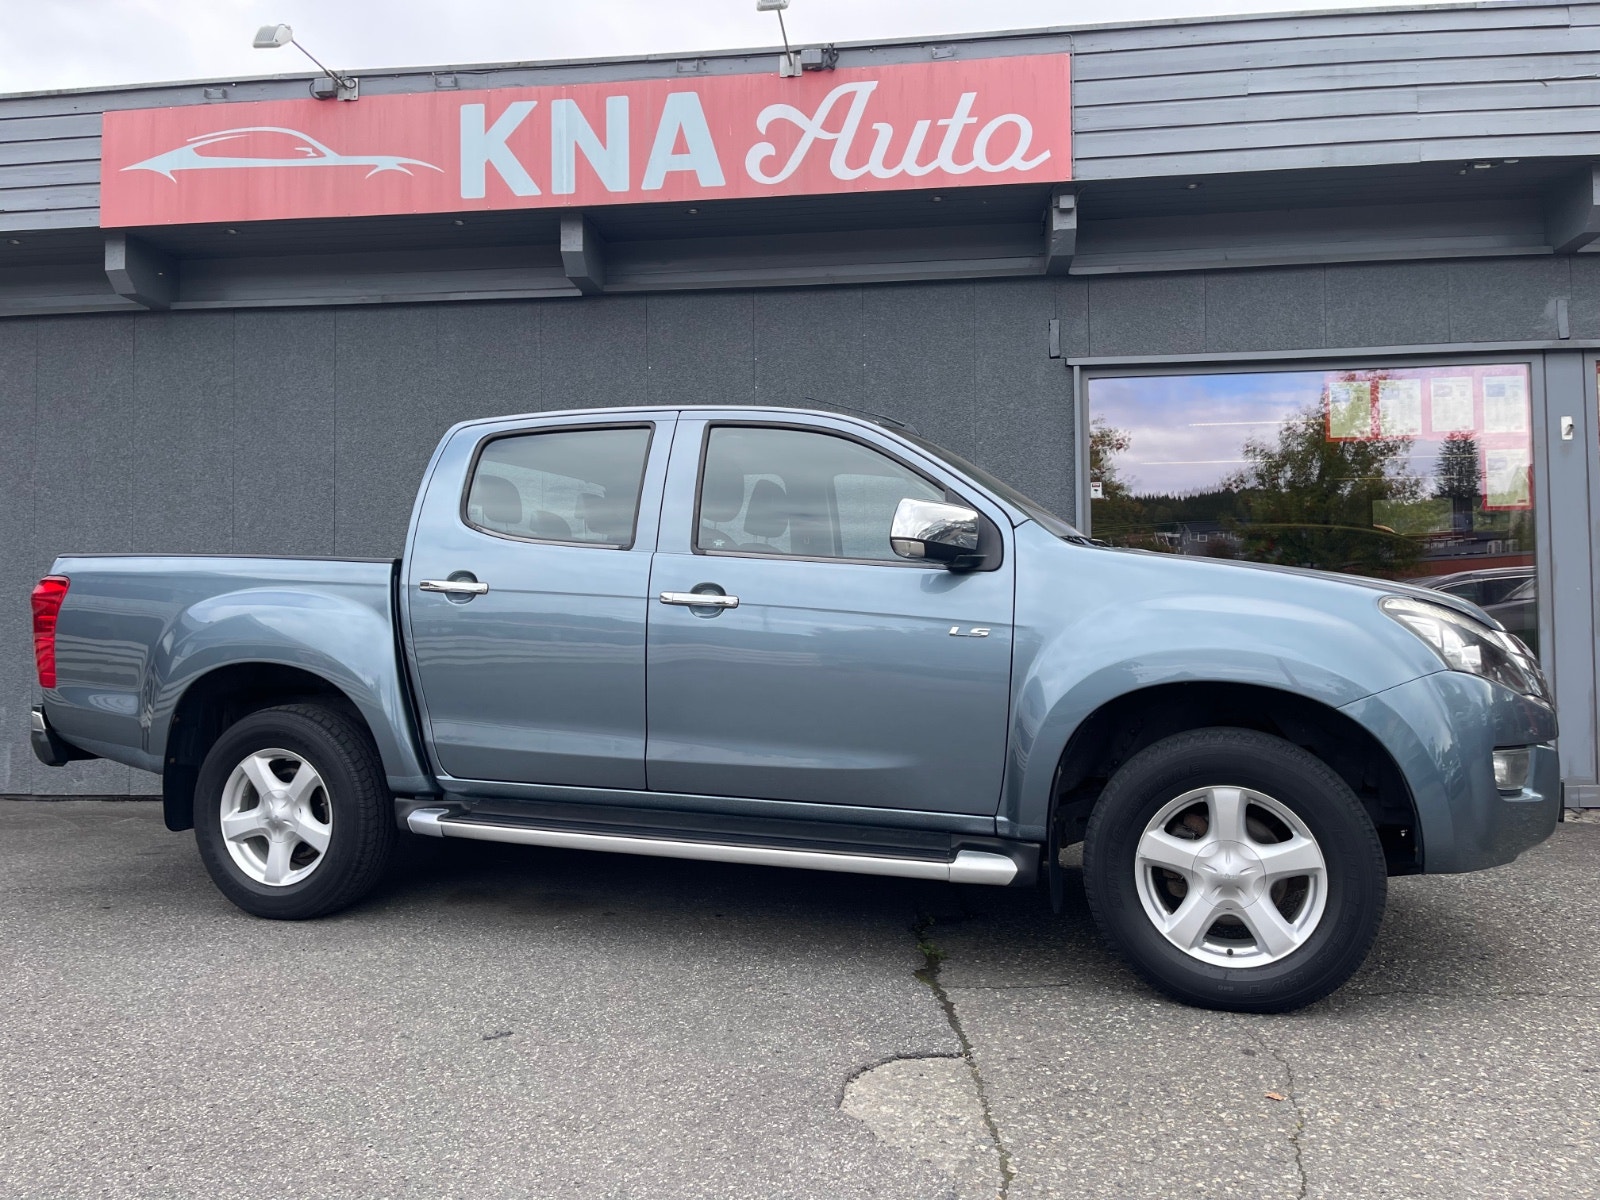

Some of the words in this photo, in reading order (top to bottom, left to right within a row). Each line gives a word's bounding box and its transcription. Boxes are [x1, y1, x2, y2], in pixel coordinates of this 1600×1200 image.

[460, 91, 726, 198] KNA
[745, 81, 1051, 184] Auto
[949, 626, 991, 637] LS
